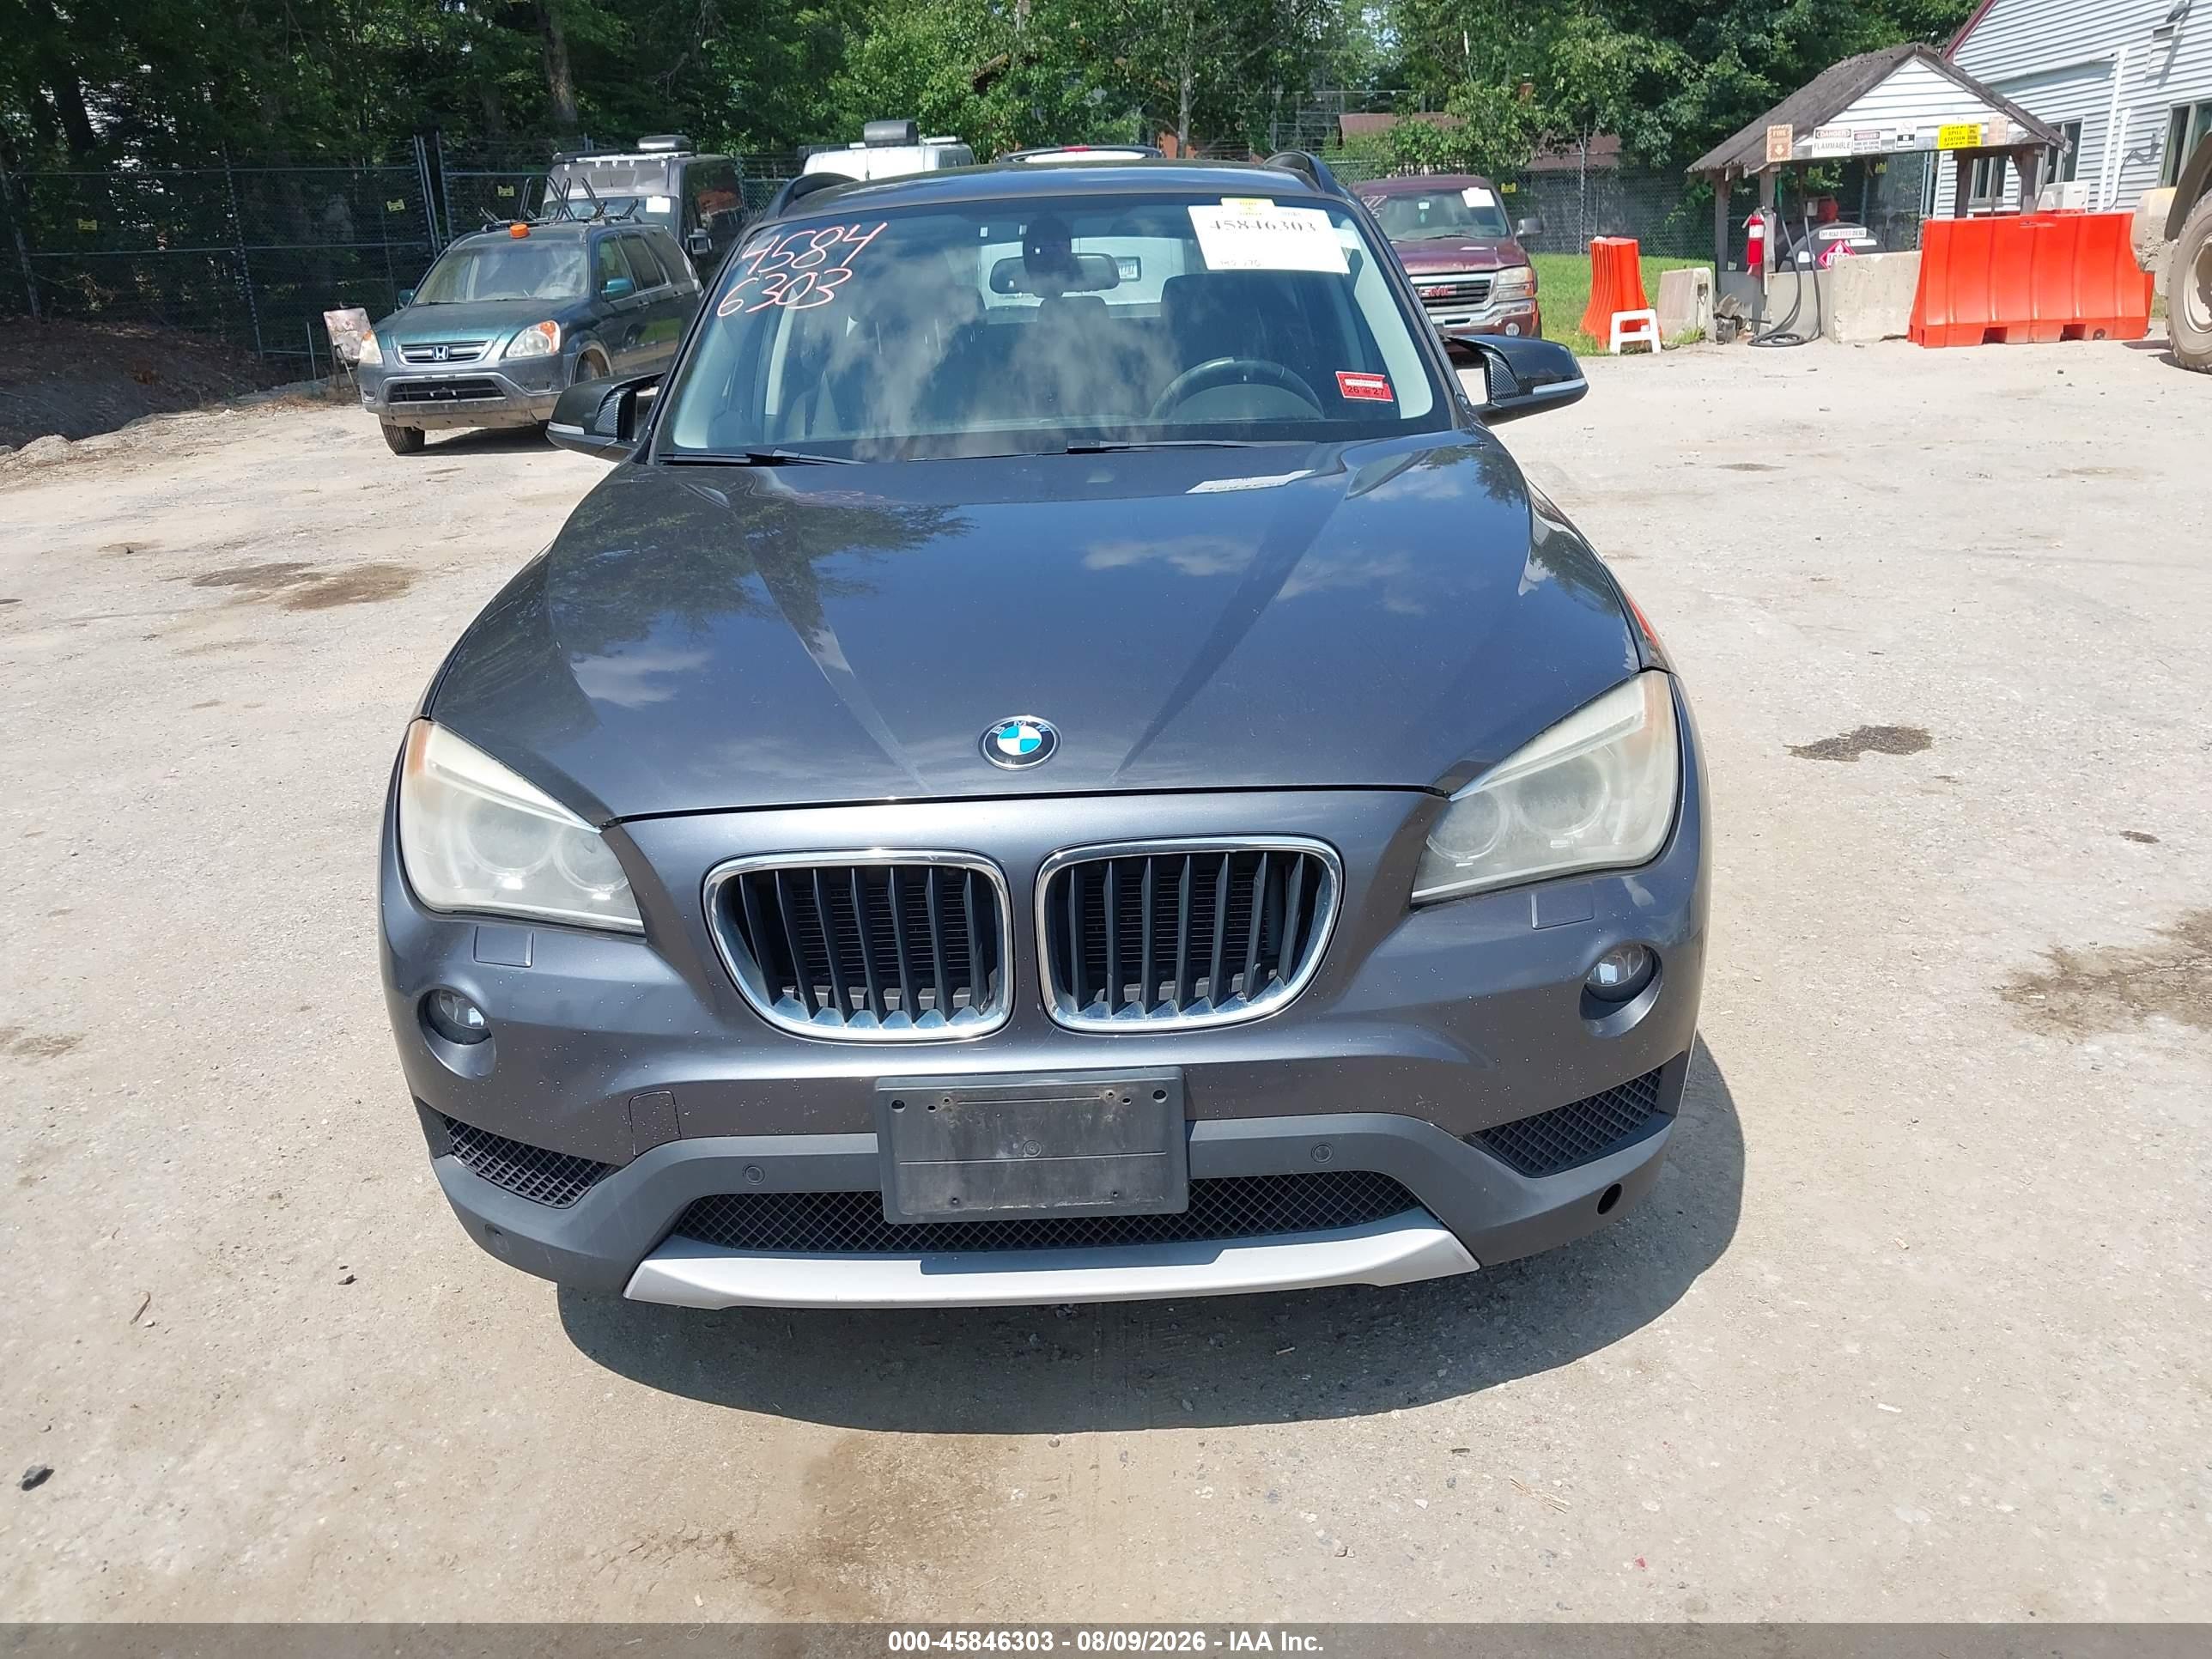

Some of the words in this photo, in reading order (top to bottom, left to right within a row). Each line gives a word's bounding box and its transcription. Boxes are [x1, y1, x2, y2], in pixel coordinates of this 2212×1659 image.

[1820, 129, 1847, 138] DANGER
[1814, 141, 1851, 150] FLAMMABLE
[1210, 220, 1316, 232] 45846303
[741, 222, 889, 276] 4584
[716, 267, 853, 317] 6303
[1418, 283, 1457, 298] GMC
[1373, 387, 1384, 396] 27
[991, 720, 1049, 735] BMW
